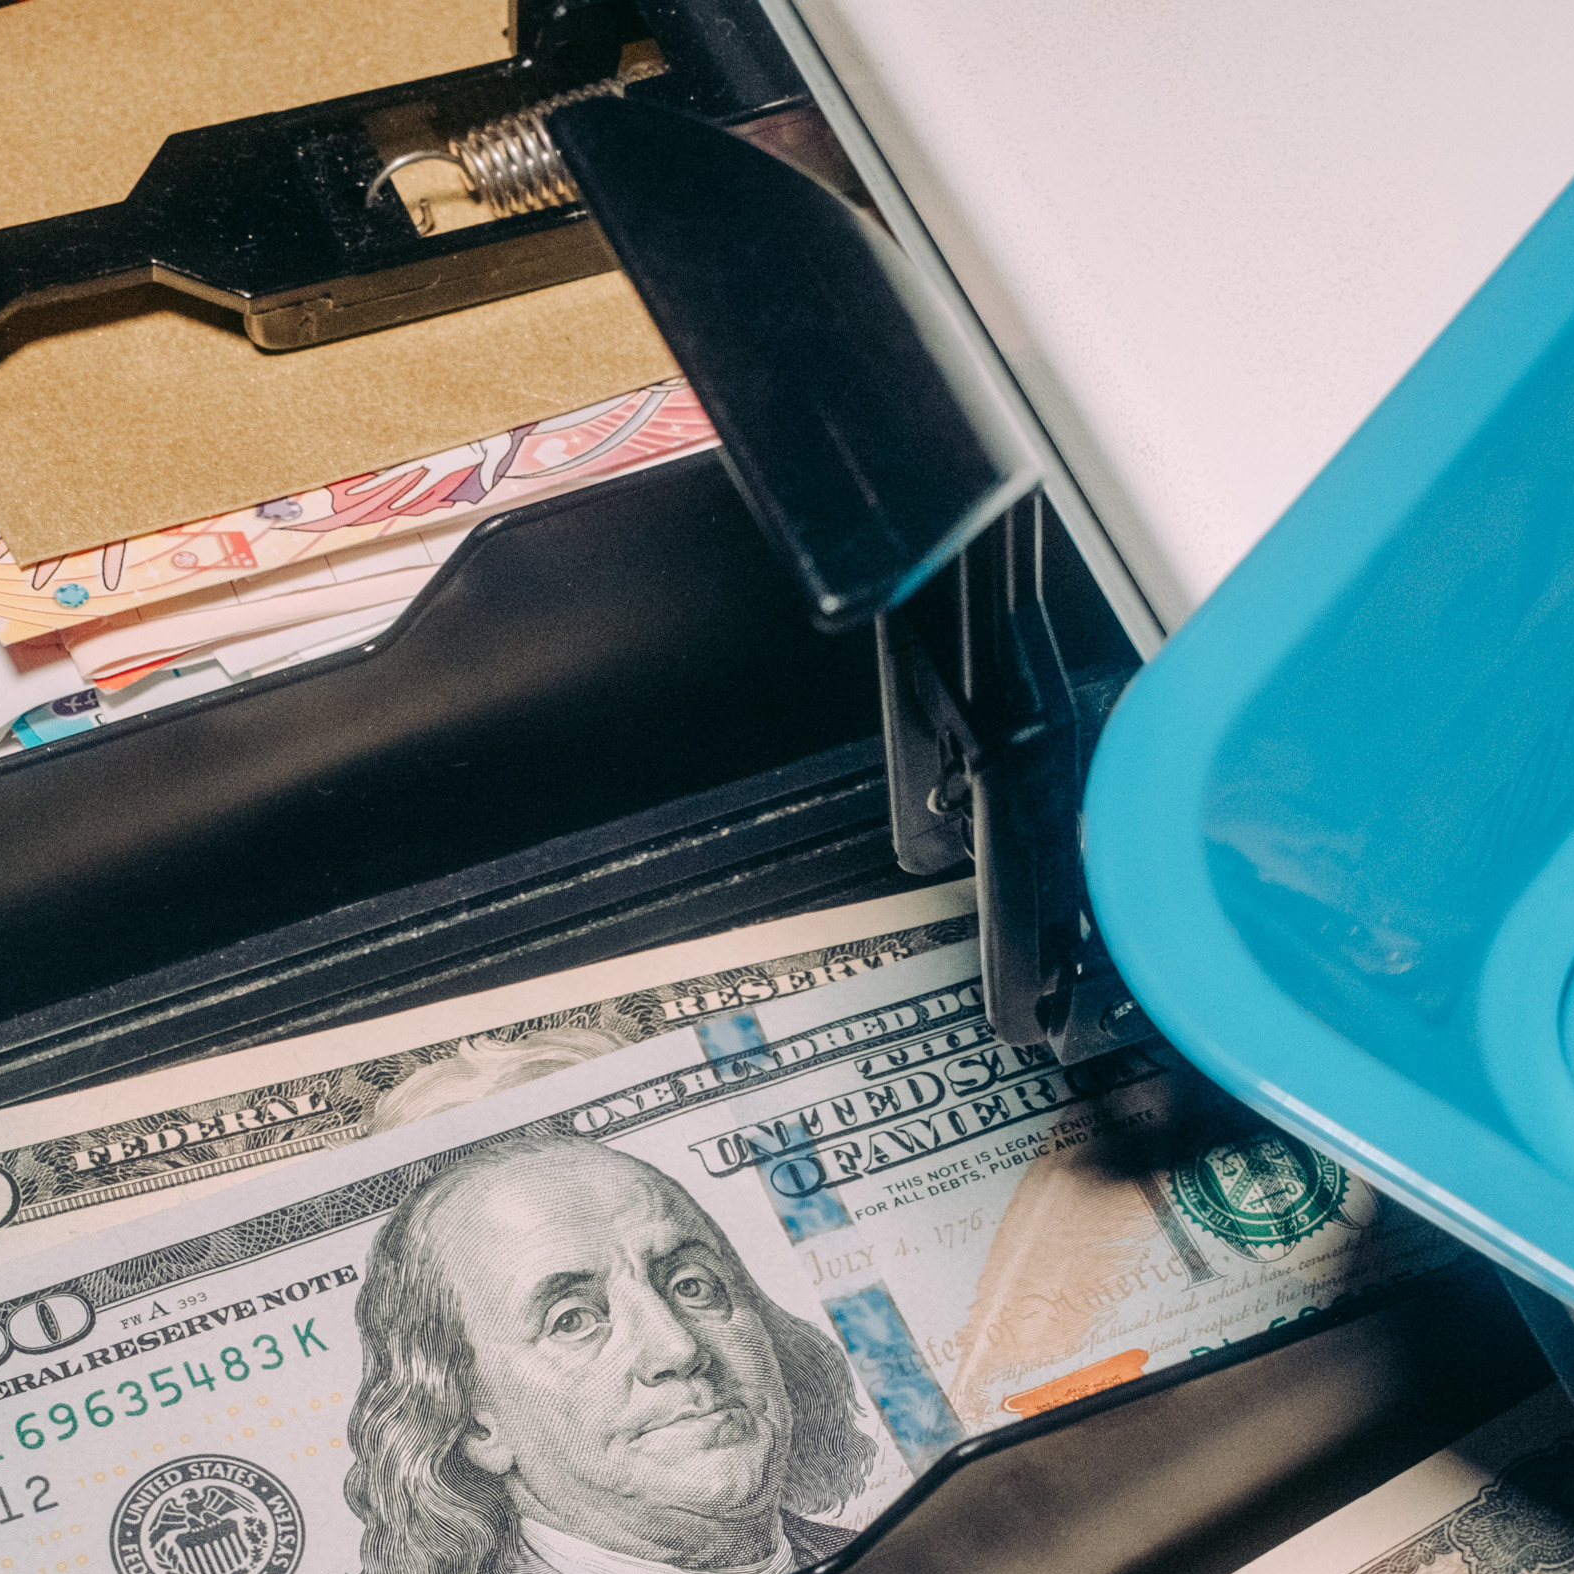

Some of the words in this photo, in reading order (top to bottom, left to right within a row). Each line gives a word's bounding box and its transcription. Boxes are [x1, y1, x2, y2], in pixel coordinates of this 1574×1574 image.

[67, 1088, 330, 1173] FEDERAL
[662, 945, 916, 1022] RESERVE
[572, 1078, 678, 1137] ONE
[682, 1000, 921, 1096] HUNDRED
[688, 1066, 946, 1179] UNITED
[883, 1174, 924, 1195] THIS
[928, 1160, 971, 1188] NOTE
[975, 1150, 991, 1167] IS
[996, 1130, 1049, 1158] LEGAL
[855, 1200, 891, 1221] FOR
[893, 1190, 925, 1209] ALL
[927, 1168, 987, 1198] DEBTS,
[990, 1143, 1050, 1175] PUBLIC
[1054, 1131, 1089, 1151] AND
[83, 1299, 258, 1371] RESERVE
[257, 1263, 361, 1312] NOTE
[148, 1300, 172, 1322] A
[177, 1291, 208, 1310] 393
[123, 1468, 184, 1526] UNITED
[188, 1461, 259, 1488] STATES
[266, 1494, 297, 1569] SYSTEM
